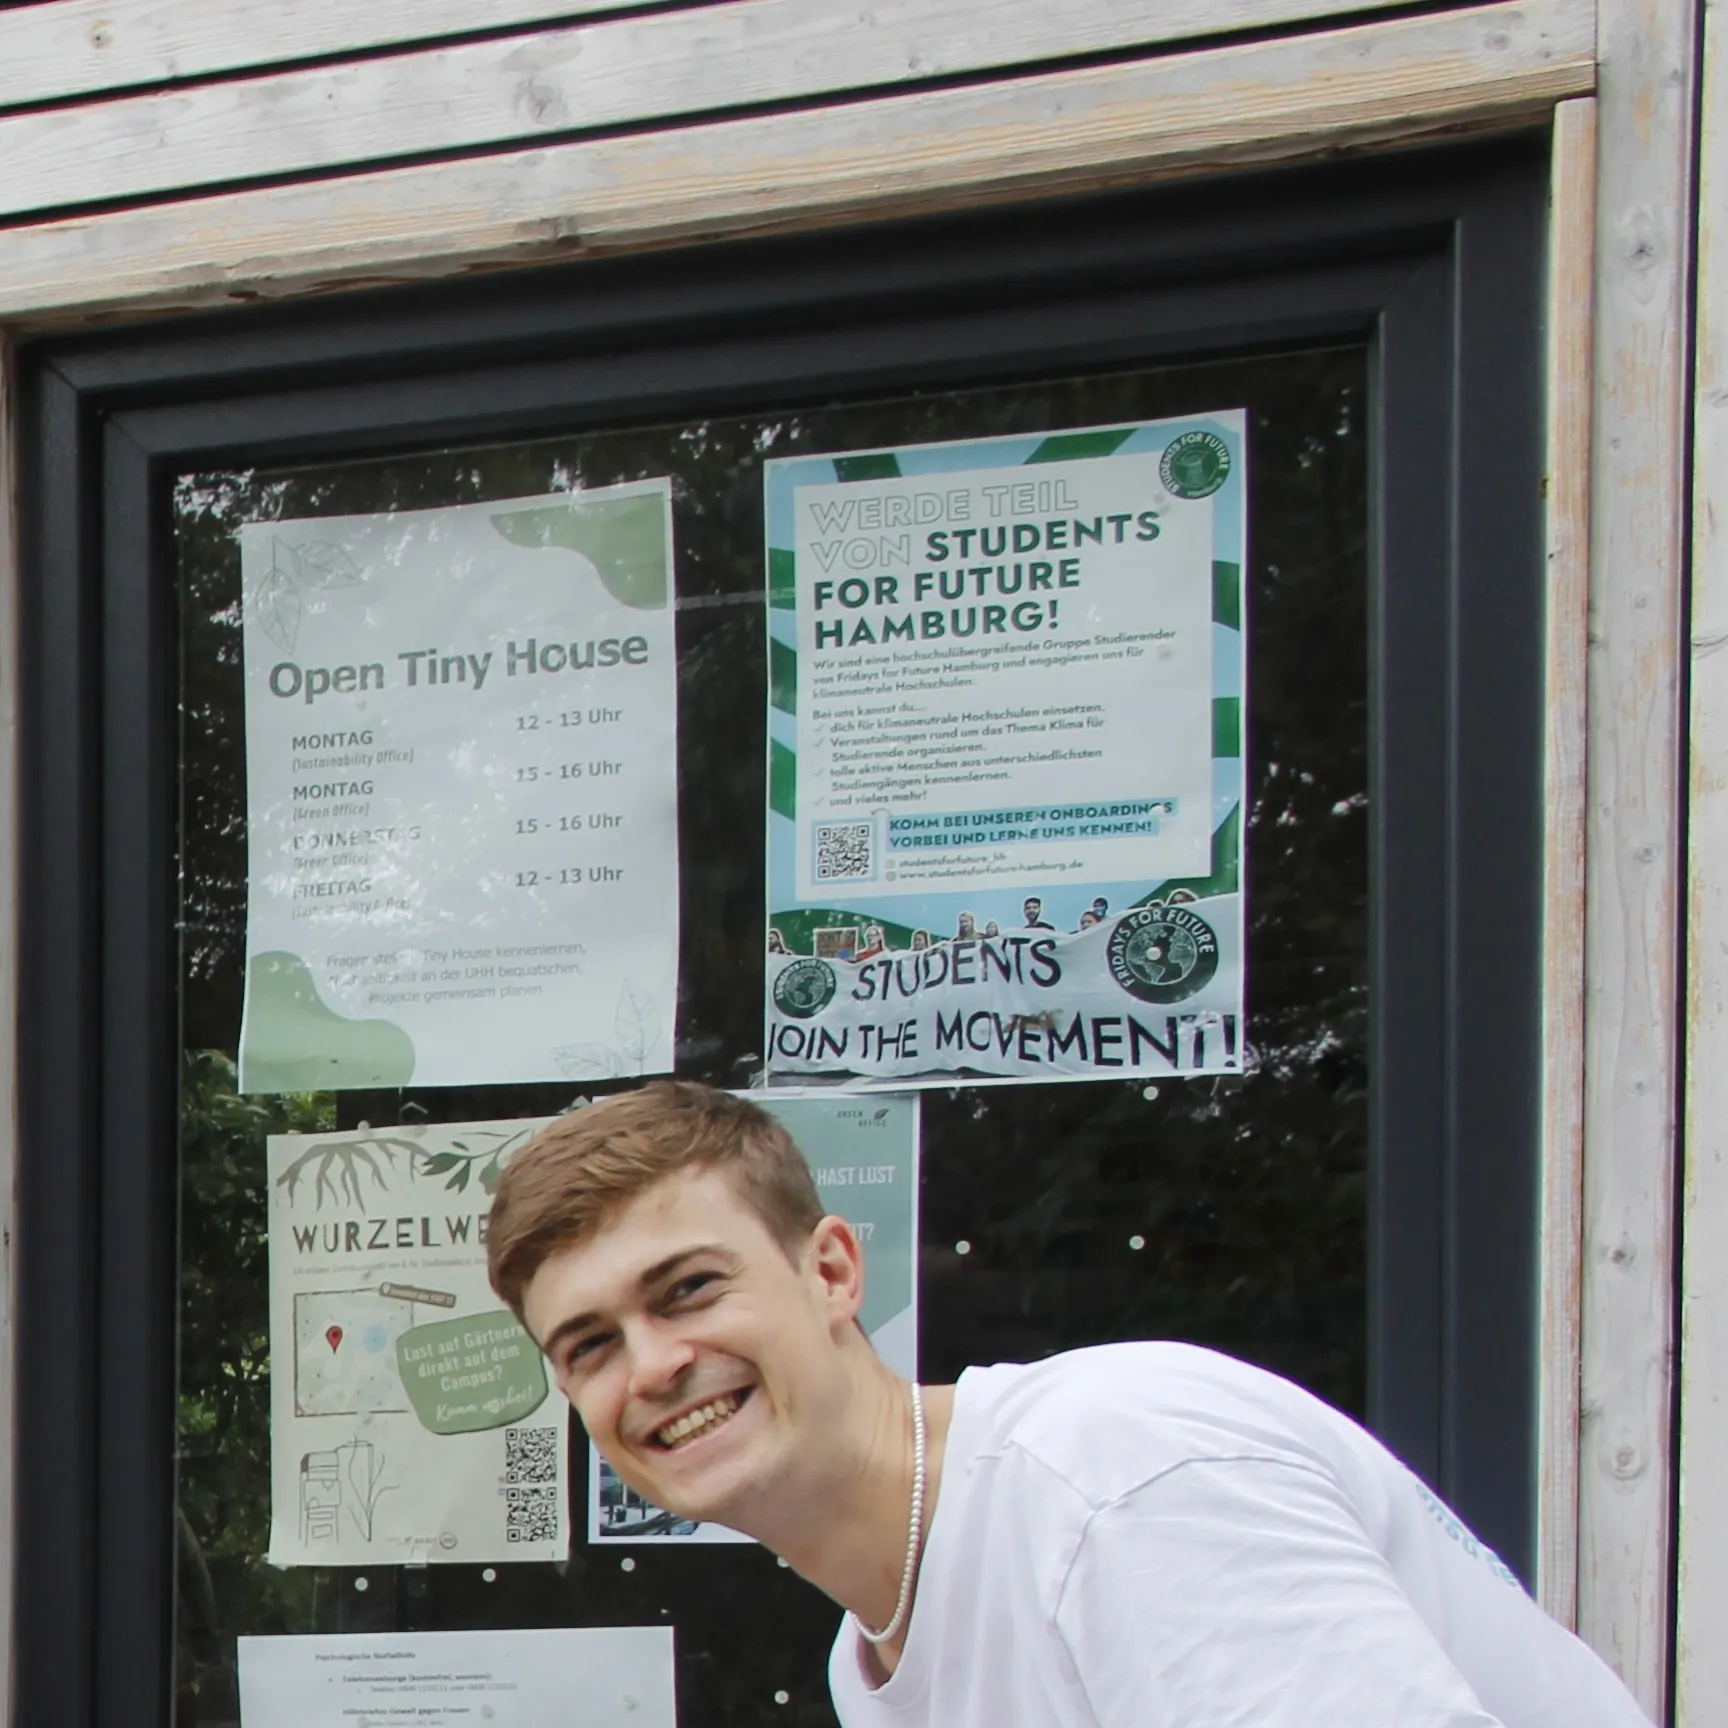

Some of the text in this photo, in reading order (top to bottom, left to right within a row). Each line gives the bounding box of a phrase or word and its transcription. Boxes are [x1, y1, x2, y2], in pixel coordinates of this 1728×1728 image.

[809, 479, 1078, 535] WERDE TEIL
[809, 511, 1161, 574] VON STUDENTS
[814, 558, 1081, 611] FOR FUTURE
[815, 599, 1059, 650] HAMBURG!
[812, 646, 1144, 686] von Fridays for Future Hamburg und engagieren uns für
[813, 629, 1176, 671] Wir sind eine hochschulübergreifende Gruppe Studierender
[268, 634, 650, 704] Open Tiny House
[812, 684, 893, 699] klimaneutrale
[813, 704, 896, 720] Bei uns kannst
[830, 703, 1106, 733] dich für klimaneutrale Hochschulen einsetzen.
[292, 707, 624, 751] MONTAG 12 13 Uhr
[830, 716, 1105, 748] Veranstaltungen rund um das Thema Klima für
[829, 748, 1104, 778] tolle aktive Menschen aus unterschiedlichsten
[831, 742, 988, 764] Studierende organisieren.
[292, 760, 624, 801] MONTAG 15 16 Uhr
[831, 770, 1013, 793] Studiengängen kennenlernen.
[829, 796, 852, 807] und
[855, 793, 889, 805] vieles
[293, 812, 624, 850] DONNERSTG 15 16 Uhr
[890, 817, 940, 832] KOMM
[944, 815, 968, 829] BEI
[972, 810, 1046, 827] UNSEREN
[890, 821, 1153, 849] VORBEI UND LERNE UNS KENNEN!
[293, 865, 625, 900] FREITAG 12 13 Uhr
[452, 946, 493, 962] House
[1111, 909, 1215, 988] FRIDAYS FOR FUTURE
[465, 965, 495, 981] UHH
[851, 937, 1062, 1001] STUDENTS
[423, 985, 497, 1004] gemeinsam
[767, 1023, 850, 1062] JOIN
[858, 1019, 919, 1063] THE
[817, 1164, 897, 1187] HAST LUST
[292, 1214, 490, 1254] WURZELWE
[404, 1343, 434, 1363] Lust
[437, 1337, 460, 1356] auf
[418, 1343, 521, 1378] direkt auf dem
[440, 1364, 503, 1393] Campus?
